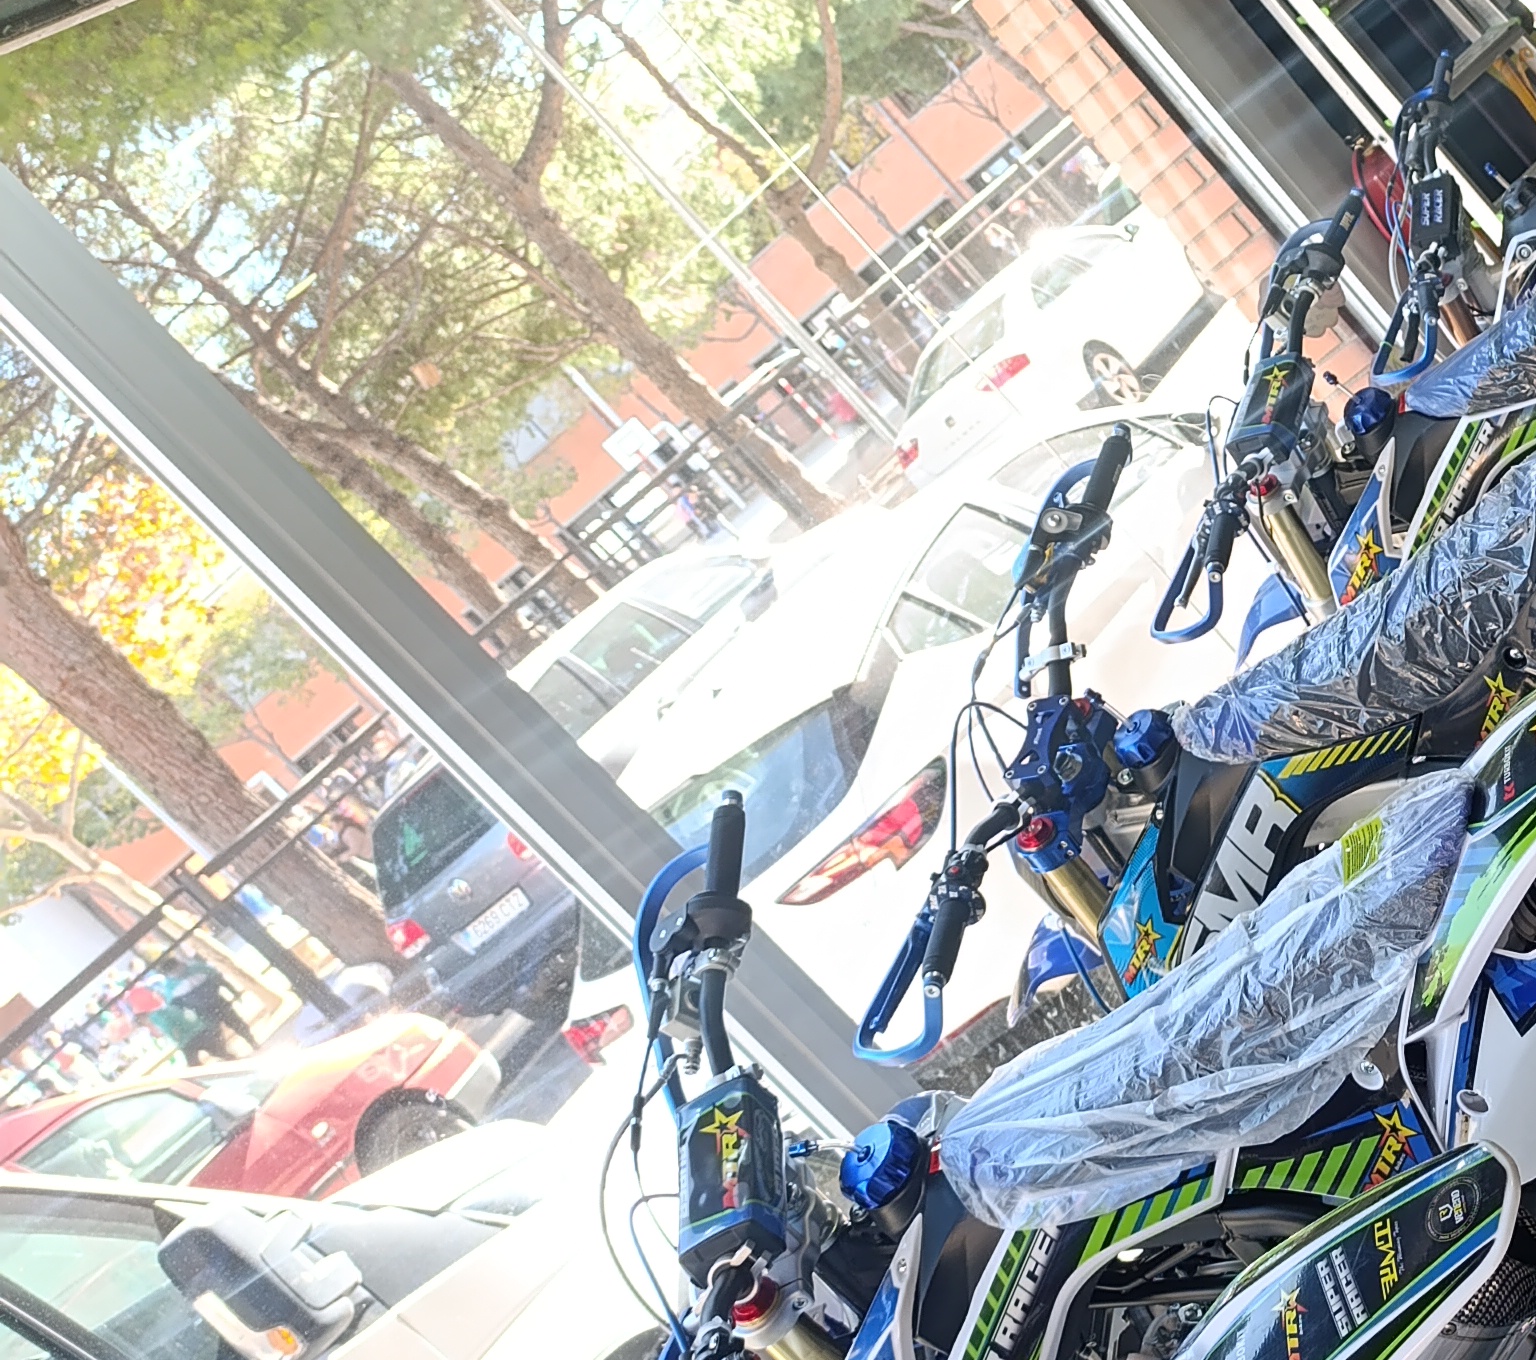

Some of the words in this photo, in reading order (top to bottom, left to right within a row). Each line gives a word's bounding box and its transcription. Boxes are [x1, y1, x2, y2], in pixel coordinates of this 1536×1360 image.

[473, 910, 500, 938] 6269
[1315, 1256, 1353, 1340] SUPER
[1330, 1244, 1371, 1328] RACER
